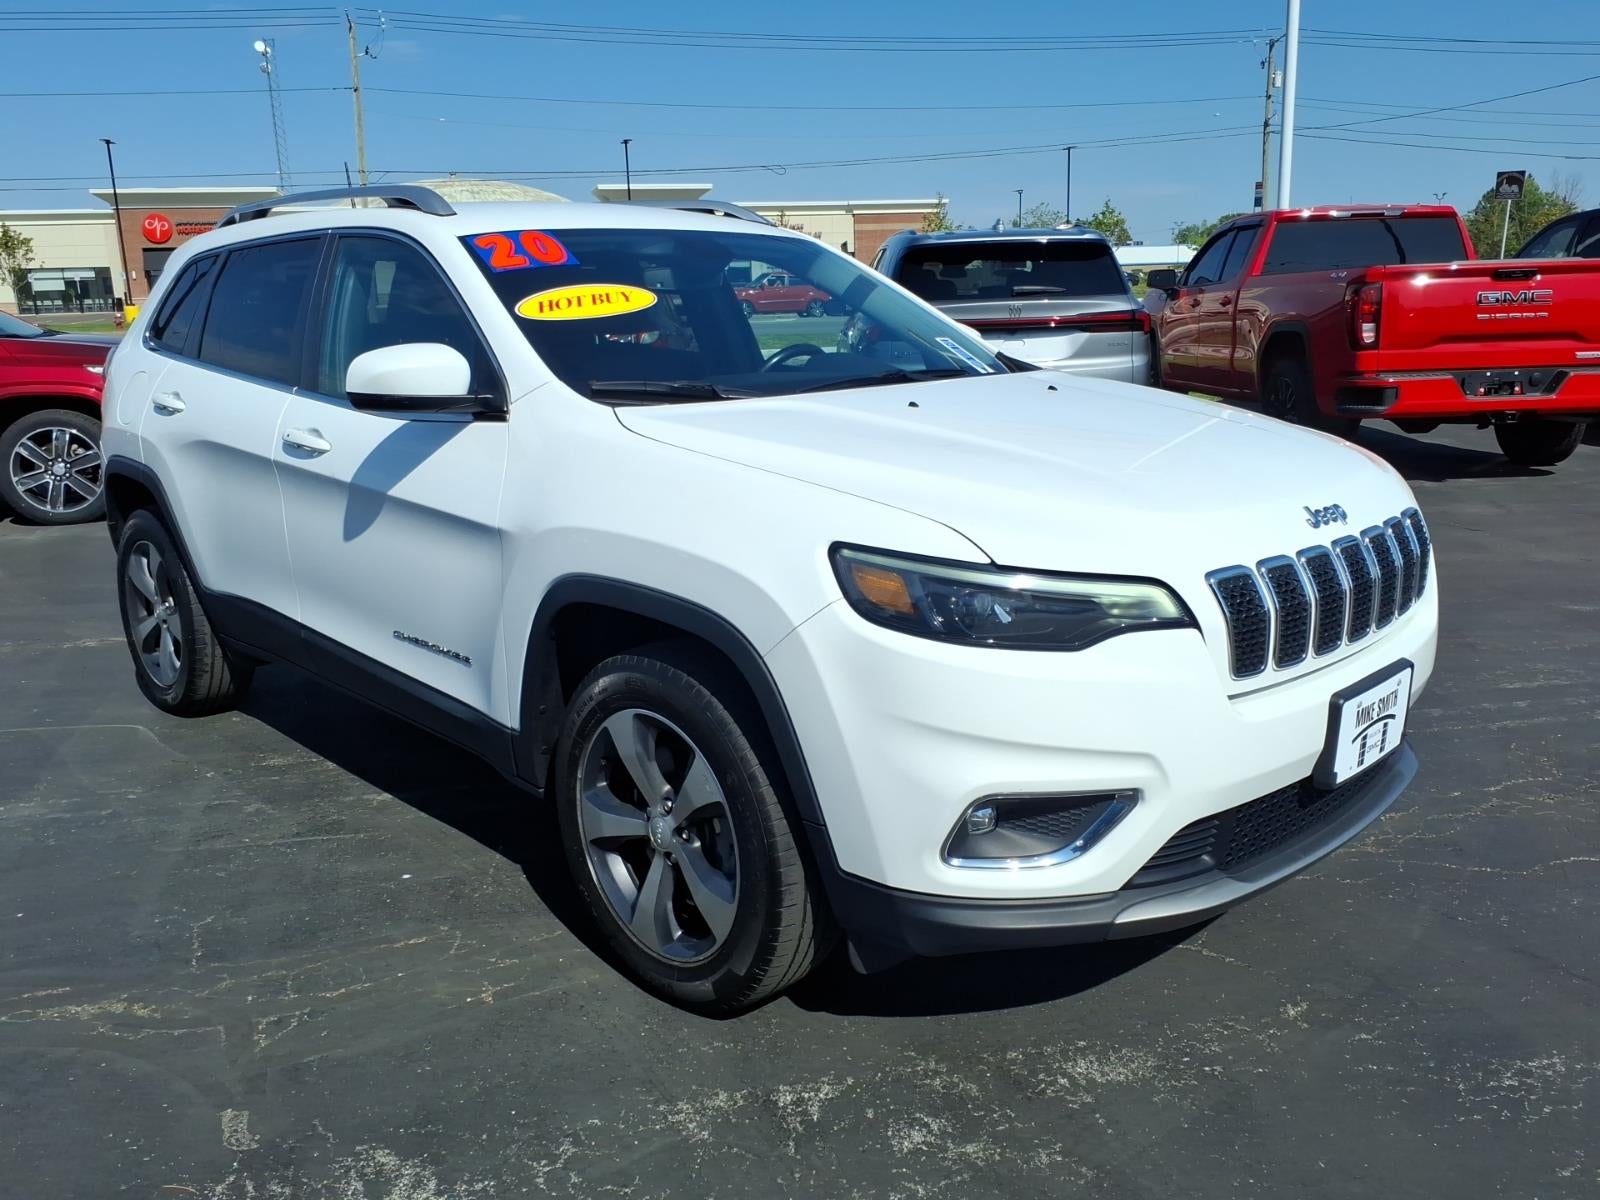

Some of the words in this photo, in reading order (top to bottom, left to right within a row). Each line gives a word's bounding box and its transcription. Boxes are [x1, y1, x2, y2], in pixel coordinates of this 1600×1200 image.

[473, 230, 568, 272] 20
[538, 295, 587, 314] HOT
[591, 290, 633, 306] BUY
[1476, 289, 1553, 306] GMC
[1476, 312, 1549, 320] SIERRA
[1302, 503, 1348, 529] Jeep
[393, 630, 473, 664] CHEROKEE
[1355, 701, 1375, 729] MIKE
[1376, 688, 1399, 717] SMITH
